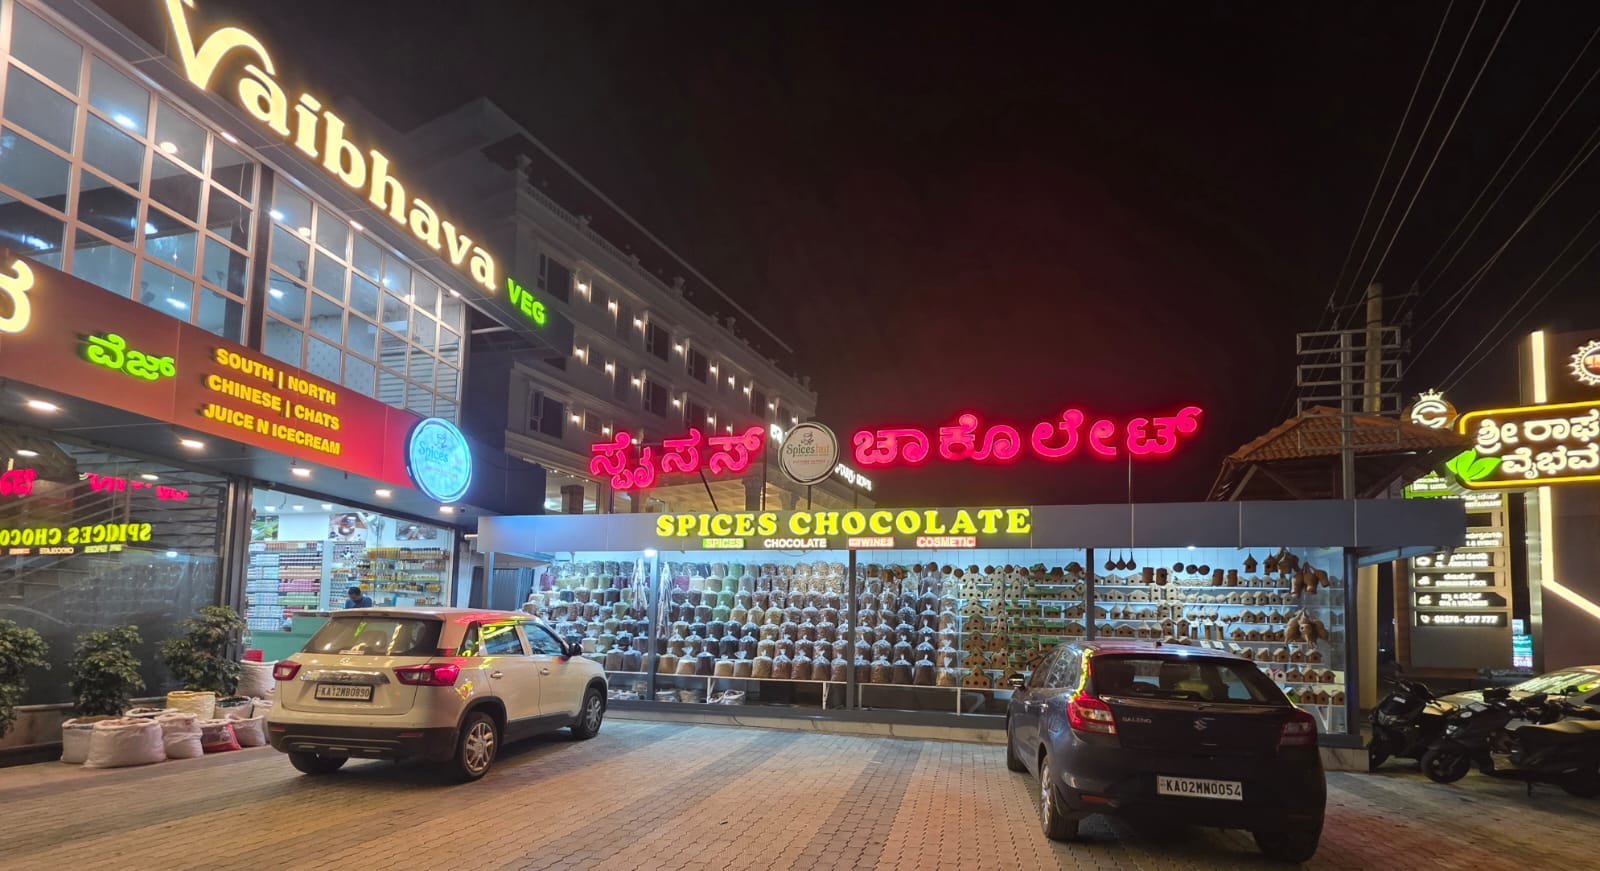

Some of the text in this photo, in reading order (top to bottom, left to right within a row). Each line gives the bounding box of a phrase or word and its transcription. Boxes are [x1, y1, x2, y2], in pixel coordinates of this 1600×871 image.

[165, 0, 497, 291] Vaibhava
[507, 277, 545, 325] VEG
[216, 348, 337, 405] SOUTH NORTH
[208, 374, 340, 430] CHINESE CHATS
[204, 403, 341, 455] JUICE N ICECREAM
[1475, 418, 1519, 455] ಶ್ರೀ
[656, 508, 1031, 537] SPICES CHOCOLATE
[705, 538, 744, 548] SPICES
[763, 537, 827, 548] CHOCOLATE
[917, 536, 976, 547] COSMETIC
